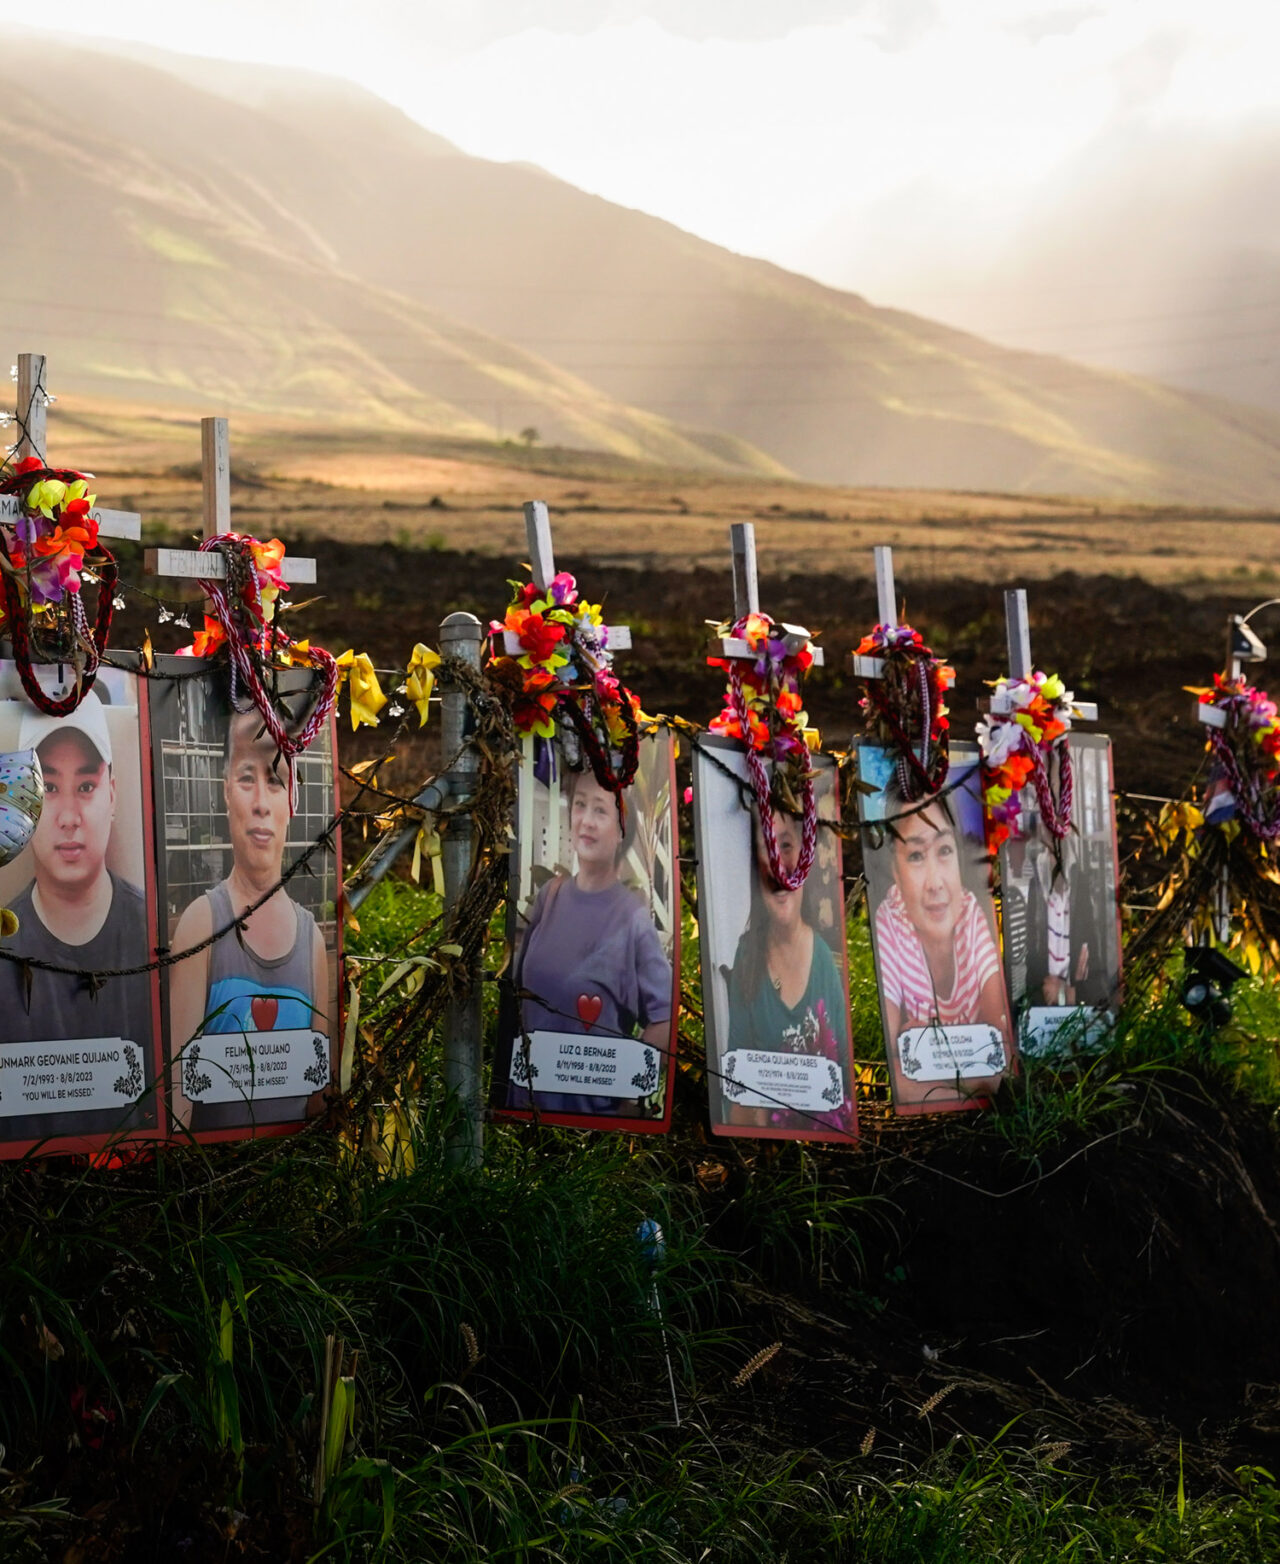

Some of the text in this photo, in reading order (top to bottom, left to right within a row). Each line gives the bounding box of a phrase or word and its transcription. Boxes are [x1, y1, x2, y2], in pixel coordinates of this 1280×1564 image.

[225, 1042, 291, 1058] FELIMN QUIJANO
[559, 1044, 573, 1055] LUZ
[583, 1046, 617, 1059] BERNABE
[37, 1052, 80, 1067] GEOVANIE
[81, 1050, 120, 1064] QUIJANO
[260, 1061, 288, 1073] 8/8/2023
[22, 1074, 55, 1088] 7/2/1993
[60, 1071, 93, 1084] 8/8/2023
[257, 1078, 265, 1087] BE
[569, 1074, 583, 1084] WILL
[583, 1075, 591, 1084] BE
[40, 1090, 57, 1101] WILL
[57, 1089, 67, 1099] BE
